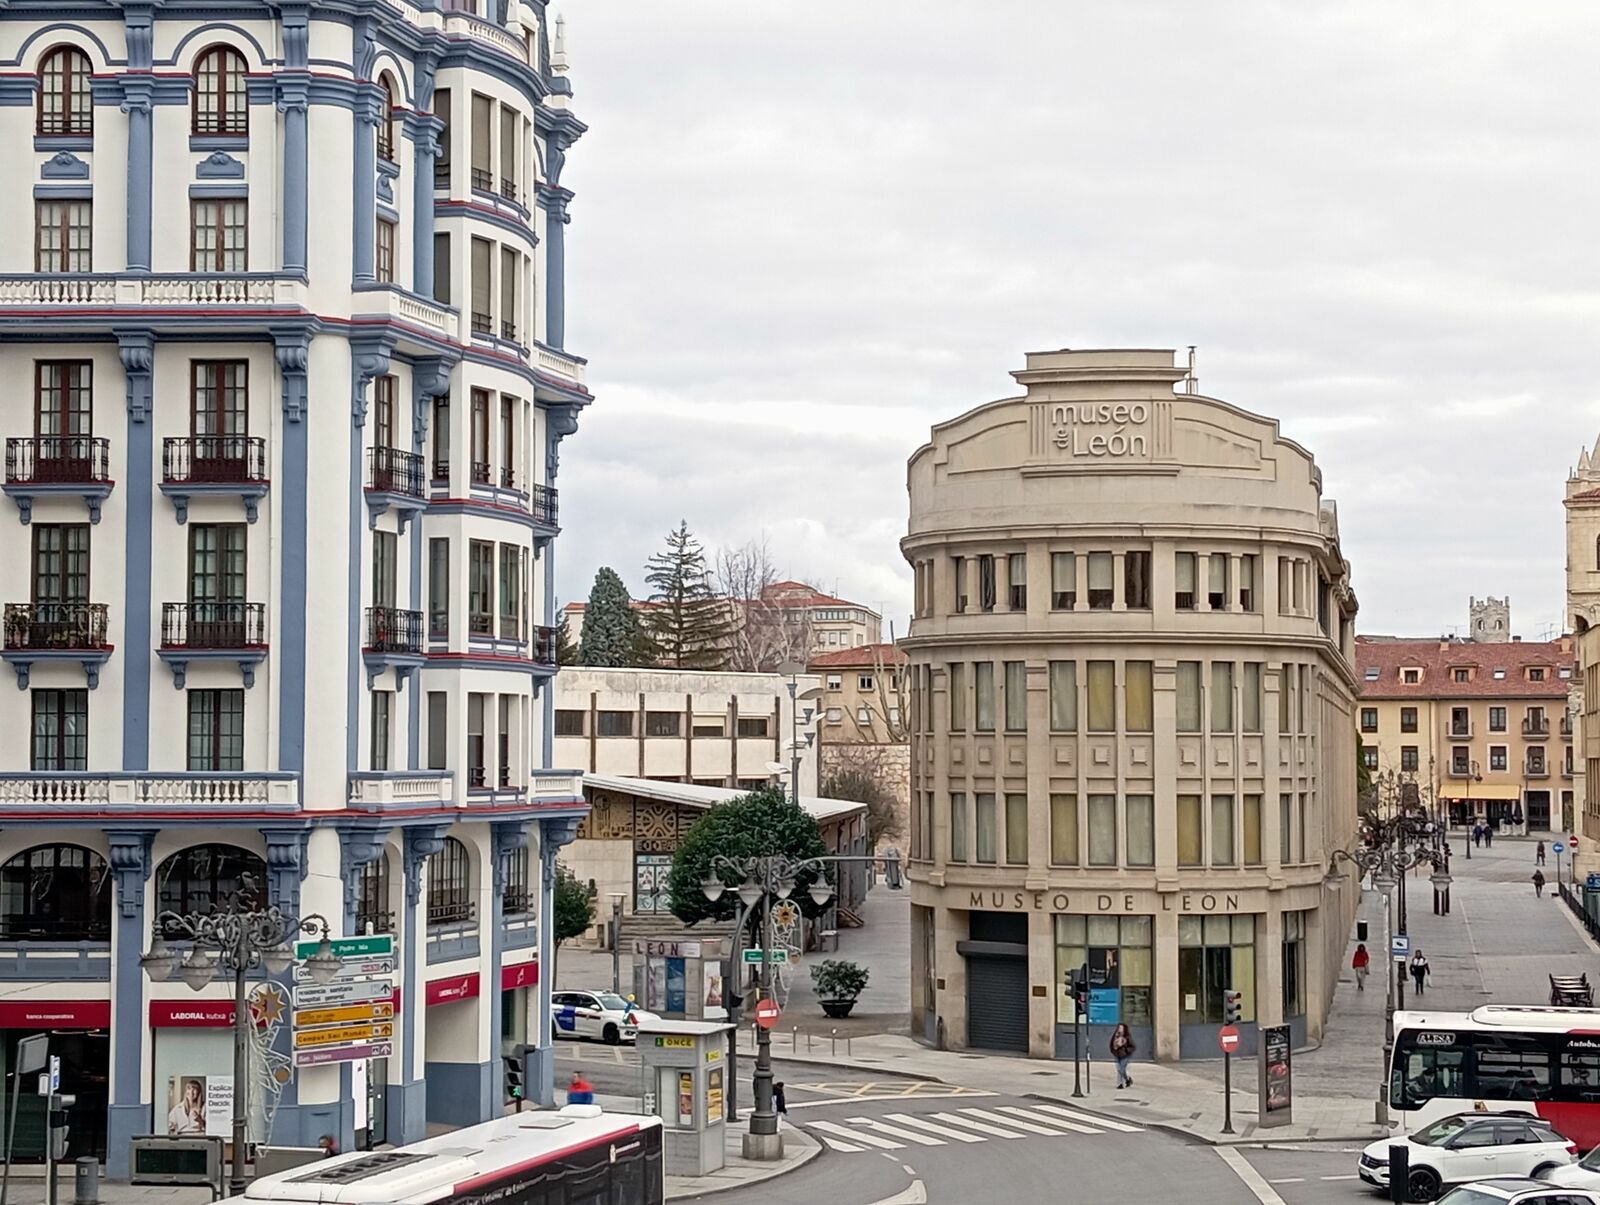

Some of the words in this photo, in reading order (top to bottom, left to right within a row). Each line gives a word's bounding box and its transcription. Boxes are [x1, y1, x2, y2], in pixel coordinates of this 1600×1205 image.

[1052, 404, 1147, 425] museo
[1052, 428, 1068, 449] de
[1073, 425, 1146, 457] León
[969, 892, 1070, 911] MUSEO
[1098, 895, 1134, 911] DE
[170, 1012, 205, 1020] LABORAL
[666, 1039, 692, 1047] ONCE
[1419, 1034, 1452, 1044] ALESA
